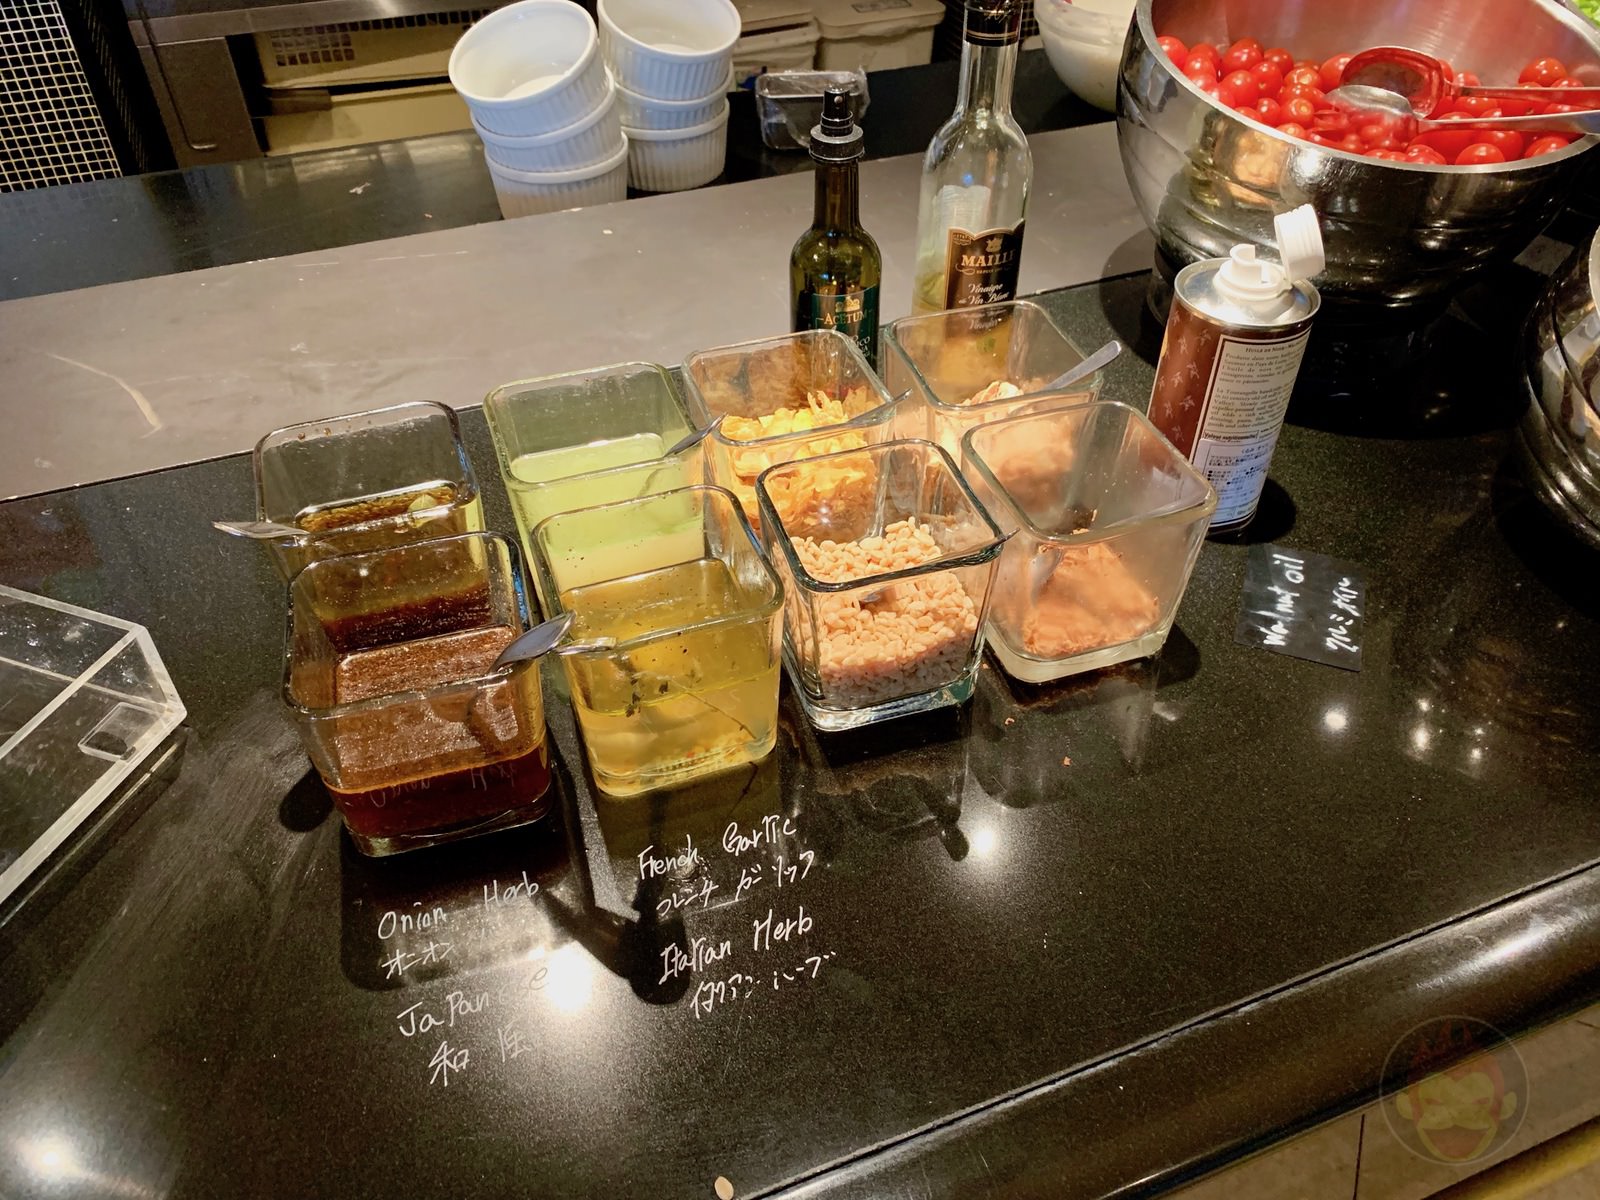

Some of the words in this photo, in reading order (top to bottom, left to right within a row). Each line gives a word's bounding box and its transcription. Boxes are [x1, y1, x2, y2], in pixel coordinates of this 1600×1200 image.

[1272, 553, 1304, 584] oil
[637, 833, 700, 880] French
[722, 814, 797, 856] Garlic
[377, 902, 448, 940] Onion
[483, 870, 539, 911] Herb
[658, 937, 732, 986] Italian
[753, 906, 813, 951] Herb
